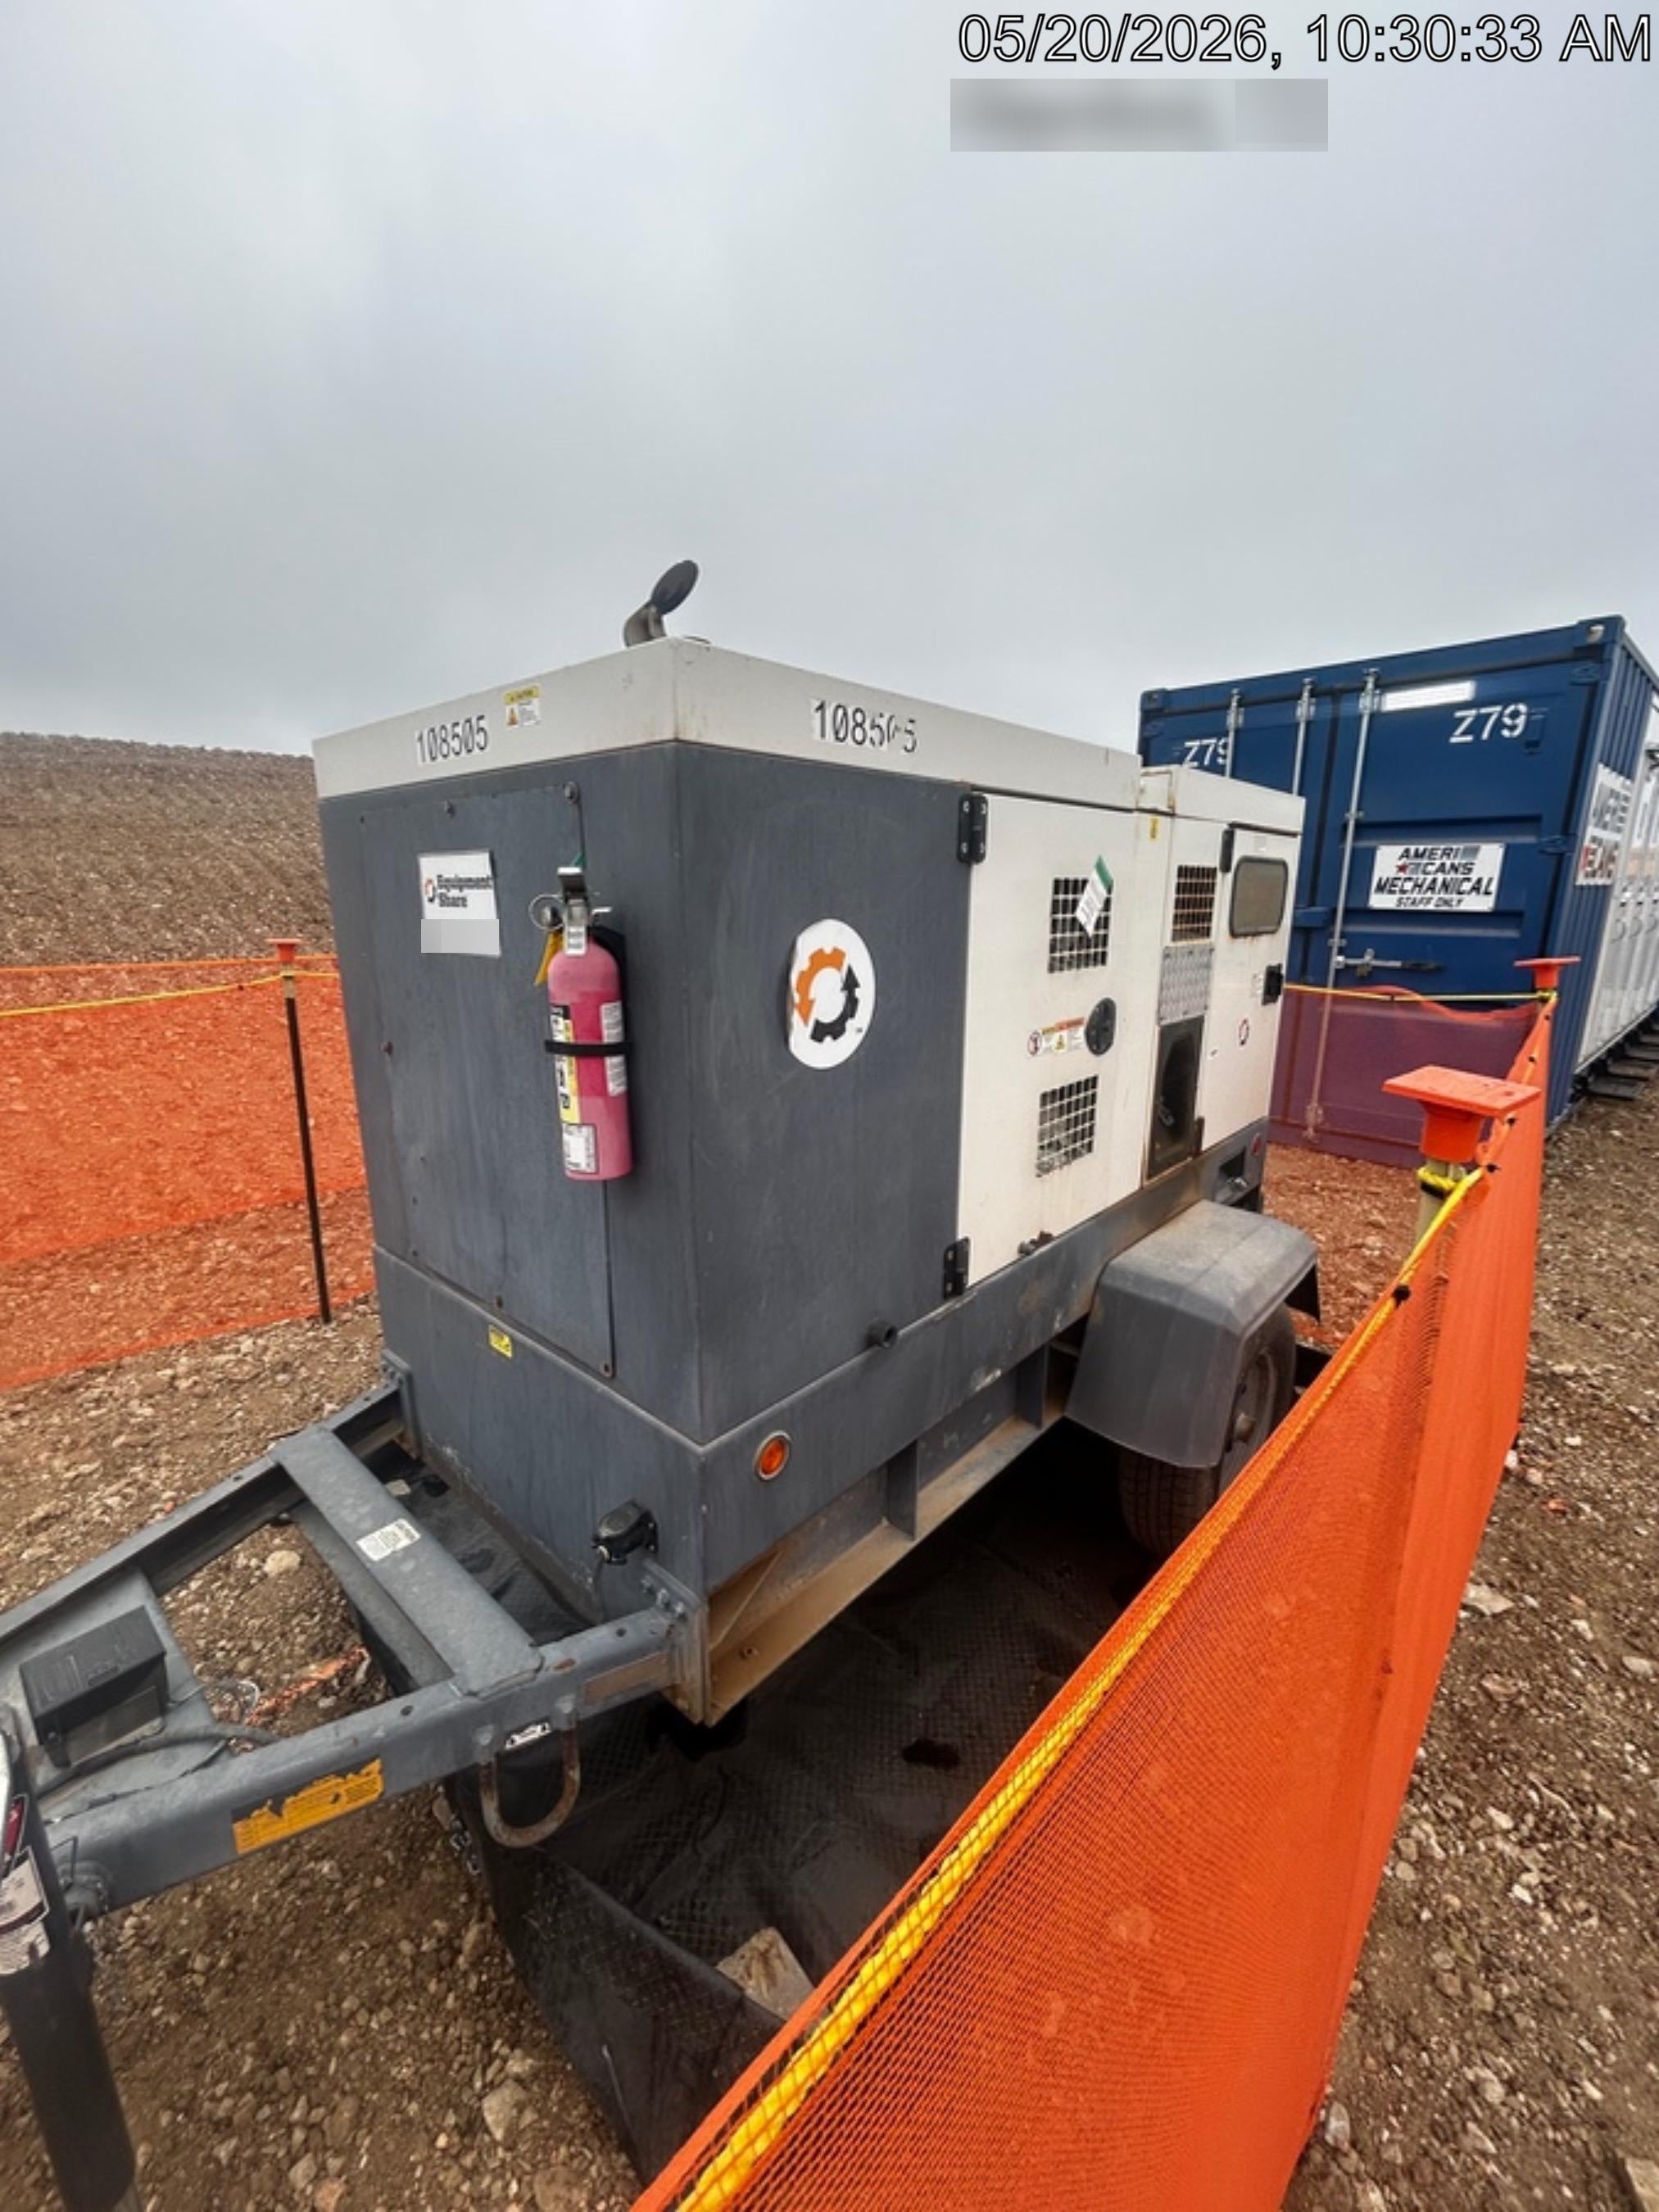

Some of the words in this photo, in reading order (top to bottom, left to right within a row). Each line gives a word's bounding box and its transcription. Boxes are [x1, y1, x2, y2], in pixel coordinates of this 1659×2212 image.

[416, 714, 489, 763] 108505
[1449, 703, 1529, 743] Z79
[1374, 877, 1494, 896] MECHANICAL
